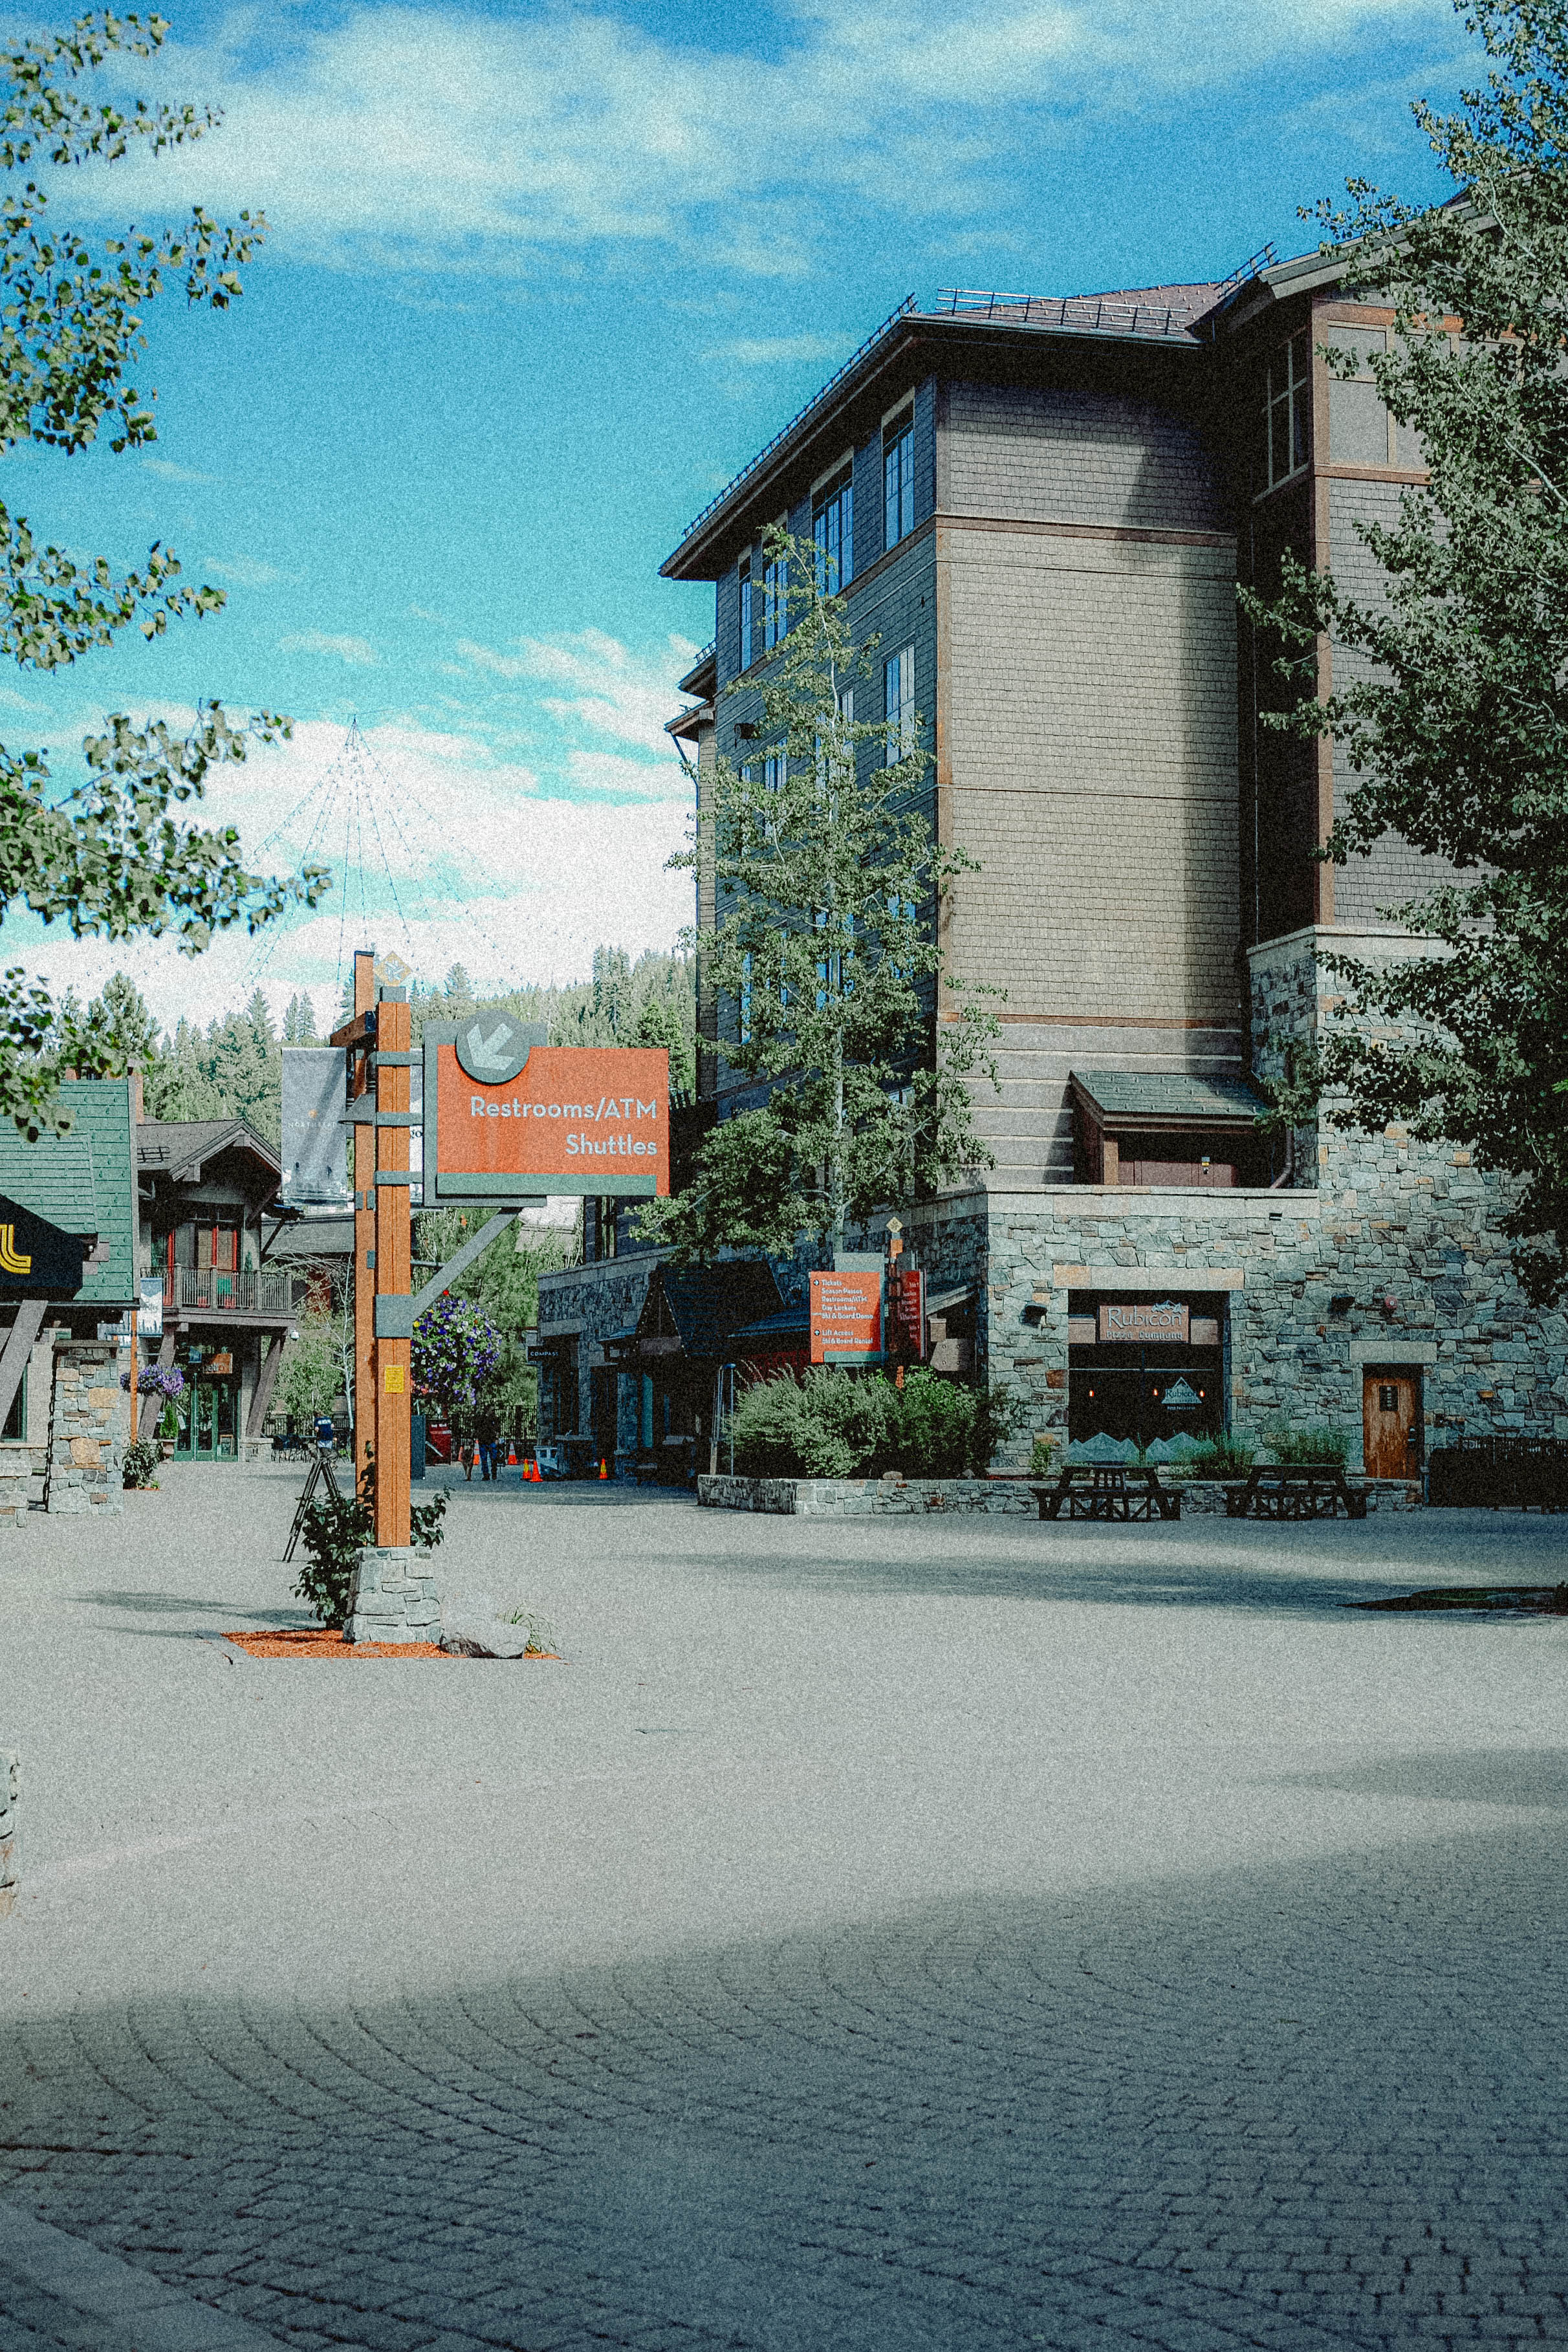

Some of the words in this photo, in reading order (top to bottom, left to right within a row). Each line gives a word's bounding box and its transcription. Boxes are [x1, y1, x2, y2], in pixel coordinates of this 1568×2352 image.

[470, 1096, 657, 1122] Restrooms/ATM
[565, 1133, 658, 1155] Shuttles
[1107, 1305, 1182, 1329] Rubicon
[1107, 1331, 1133, 1339] Pizza
[1138, 1331, 1182, 1341] Company
[1166, 1388, 1197, 1398] Rubicon
